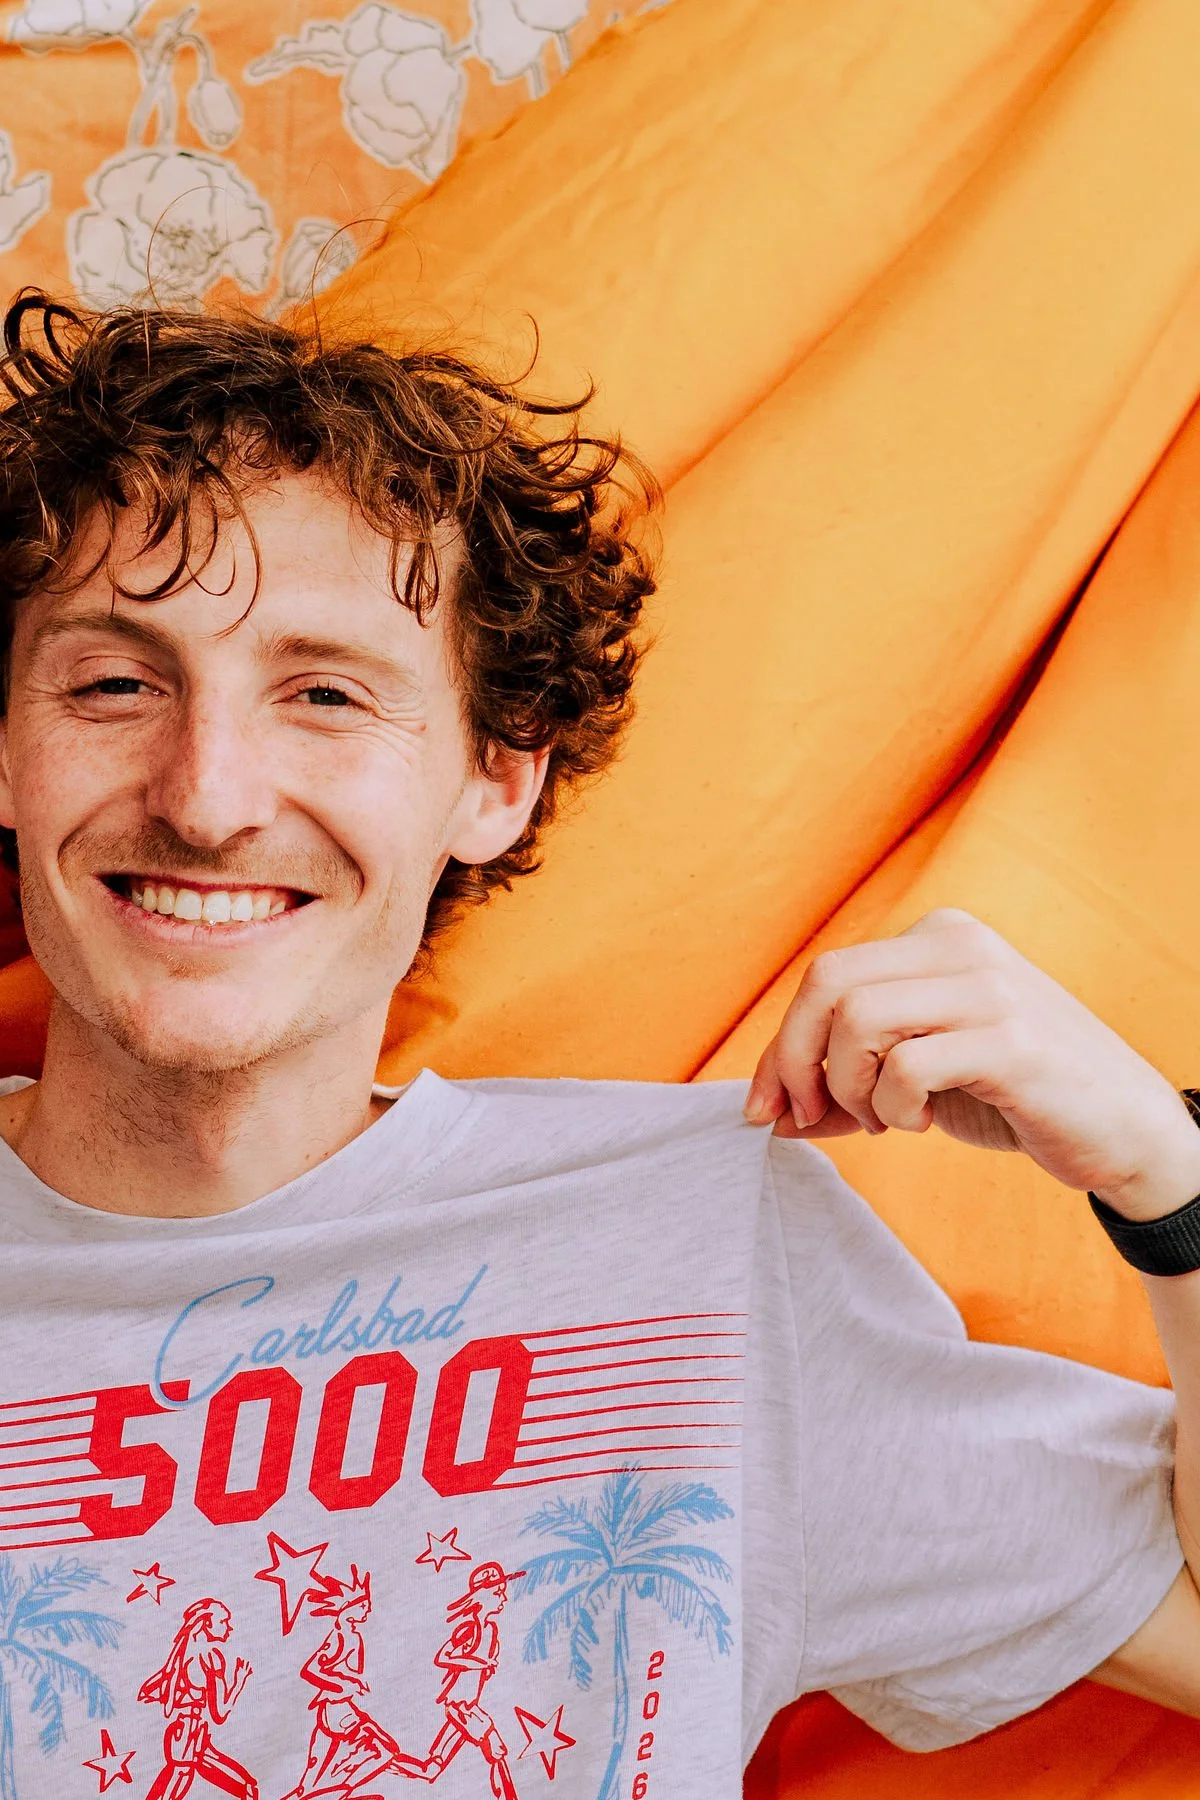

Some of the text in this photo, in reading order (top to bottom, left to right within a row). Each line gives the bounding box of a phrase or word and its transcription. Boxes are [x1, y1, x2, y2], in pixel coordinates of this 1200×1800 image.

[154, 1263, 488, 1406] Carlsbad
[79, 1335, 534, 1540] 5000
[631, 1650, 665, 1800] 2026
